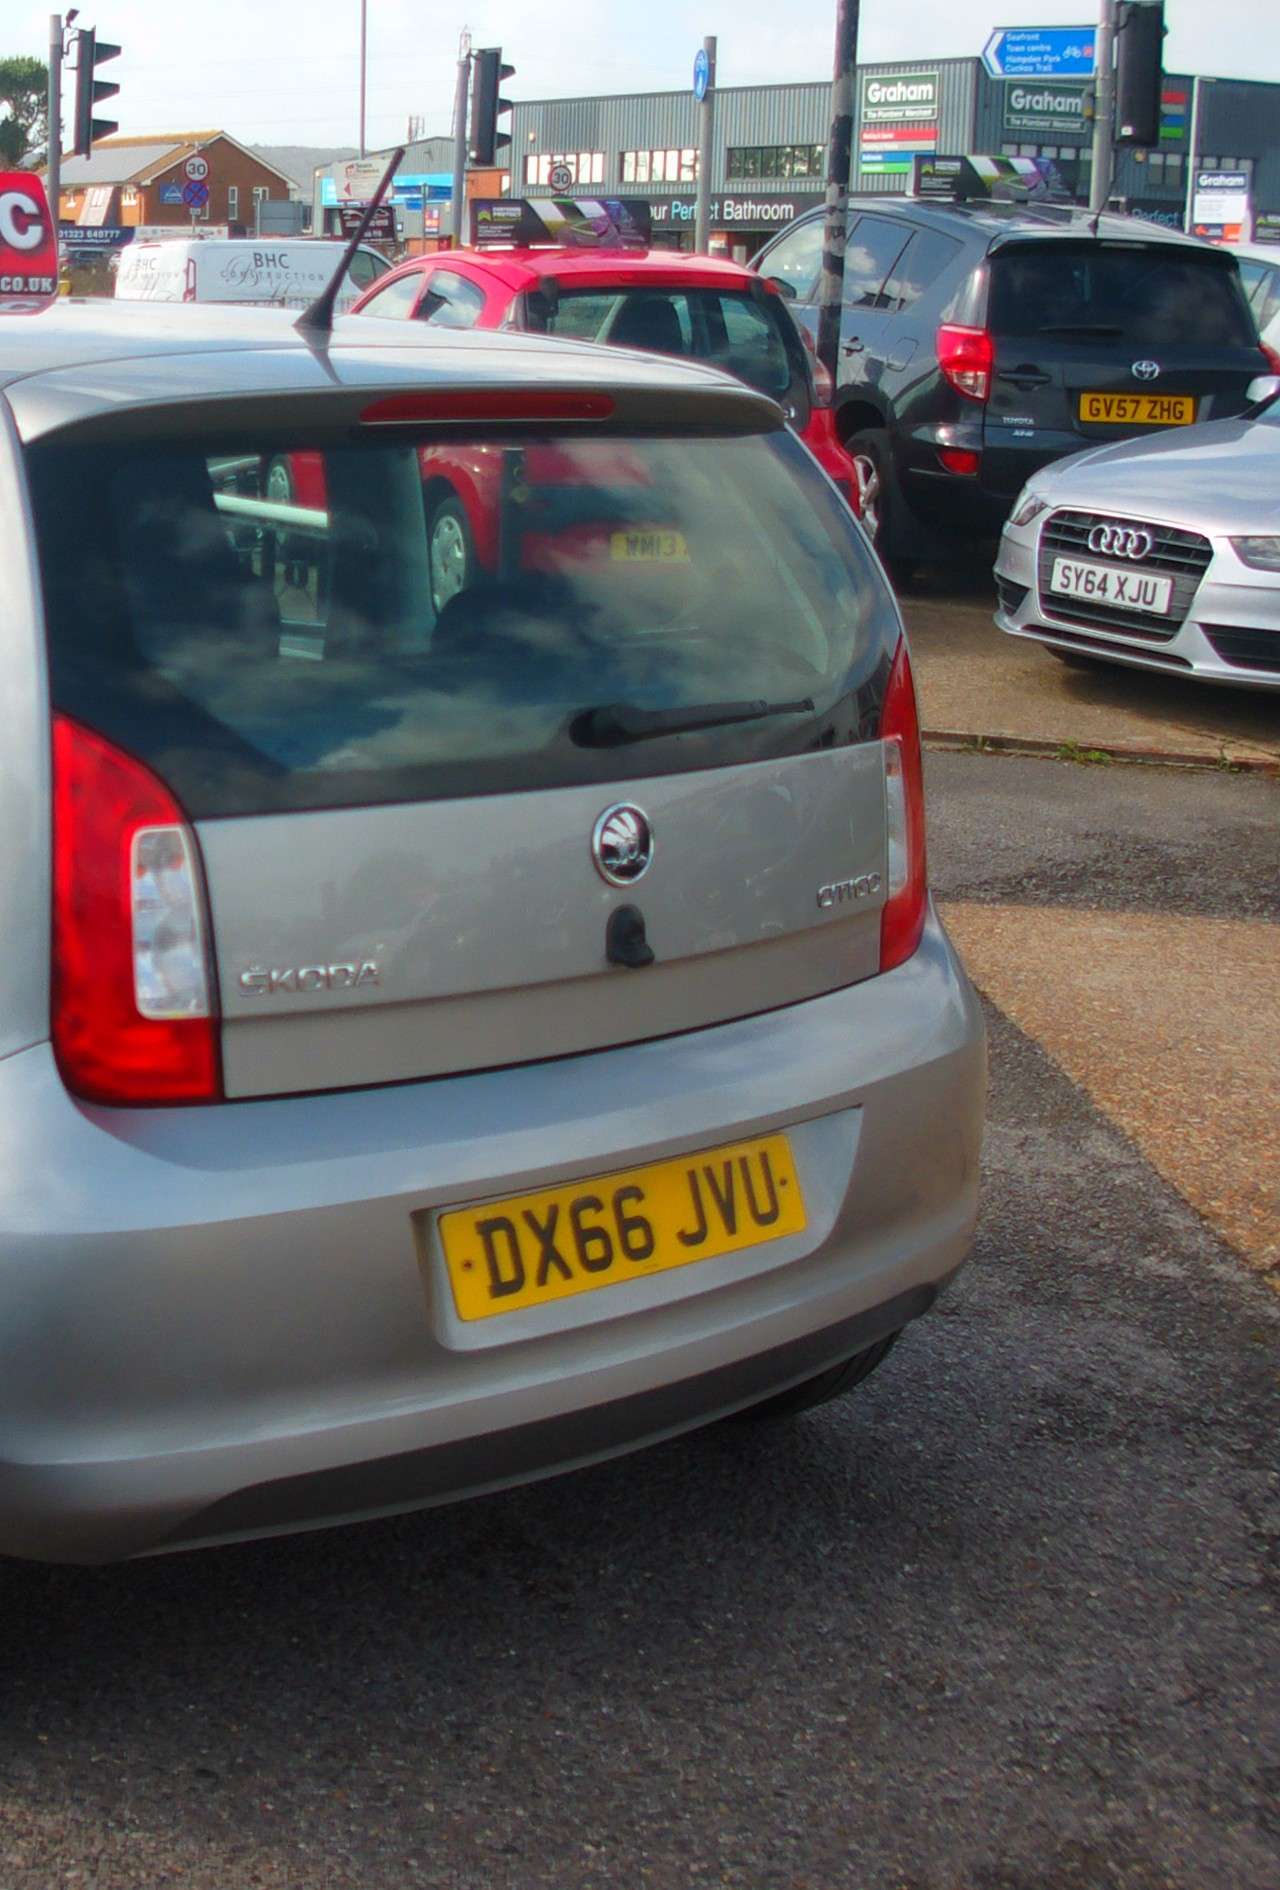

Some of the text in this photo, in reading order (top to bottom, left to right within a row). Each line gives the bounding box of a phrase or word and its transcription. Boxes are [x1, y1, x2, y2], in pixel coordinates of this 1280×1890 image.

[867, 81, 933, 103] Graham
[1011, 89, 1081, 112] Graham
[188, 163, 206, 176] 30
[553, 172, 569, 184] 30
[1199, 174, 1245, 187] Graham
[723, 200, 794, 220] Bathroom
[253, 252, 290, 269] BHC
[220, 271, 325, 281] CONSTRUCTION
[1088, 398, 1185, 420] GV57 ZHG
[1060, 565, 1158, 606] SY64 XJU
[475, 1151, 781, 1299] DX66 JVU
